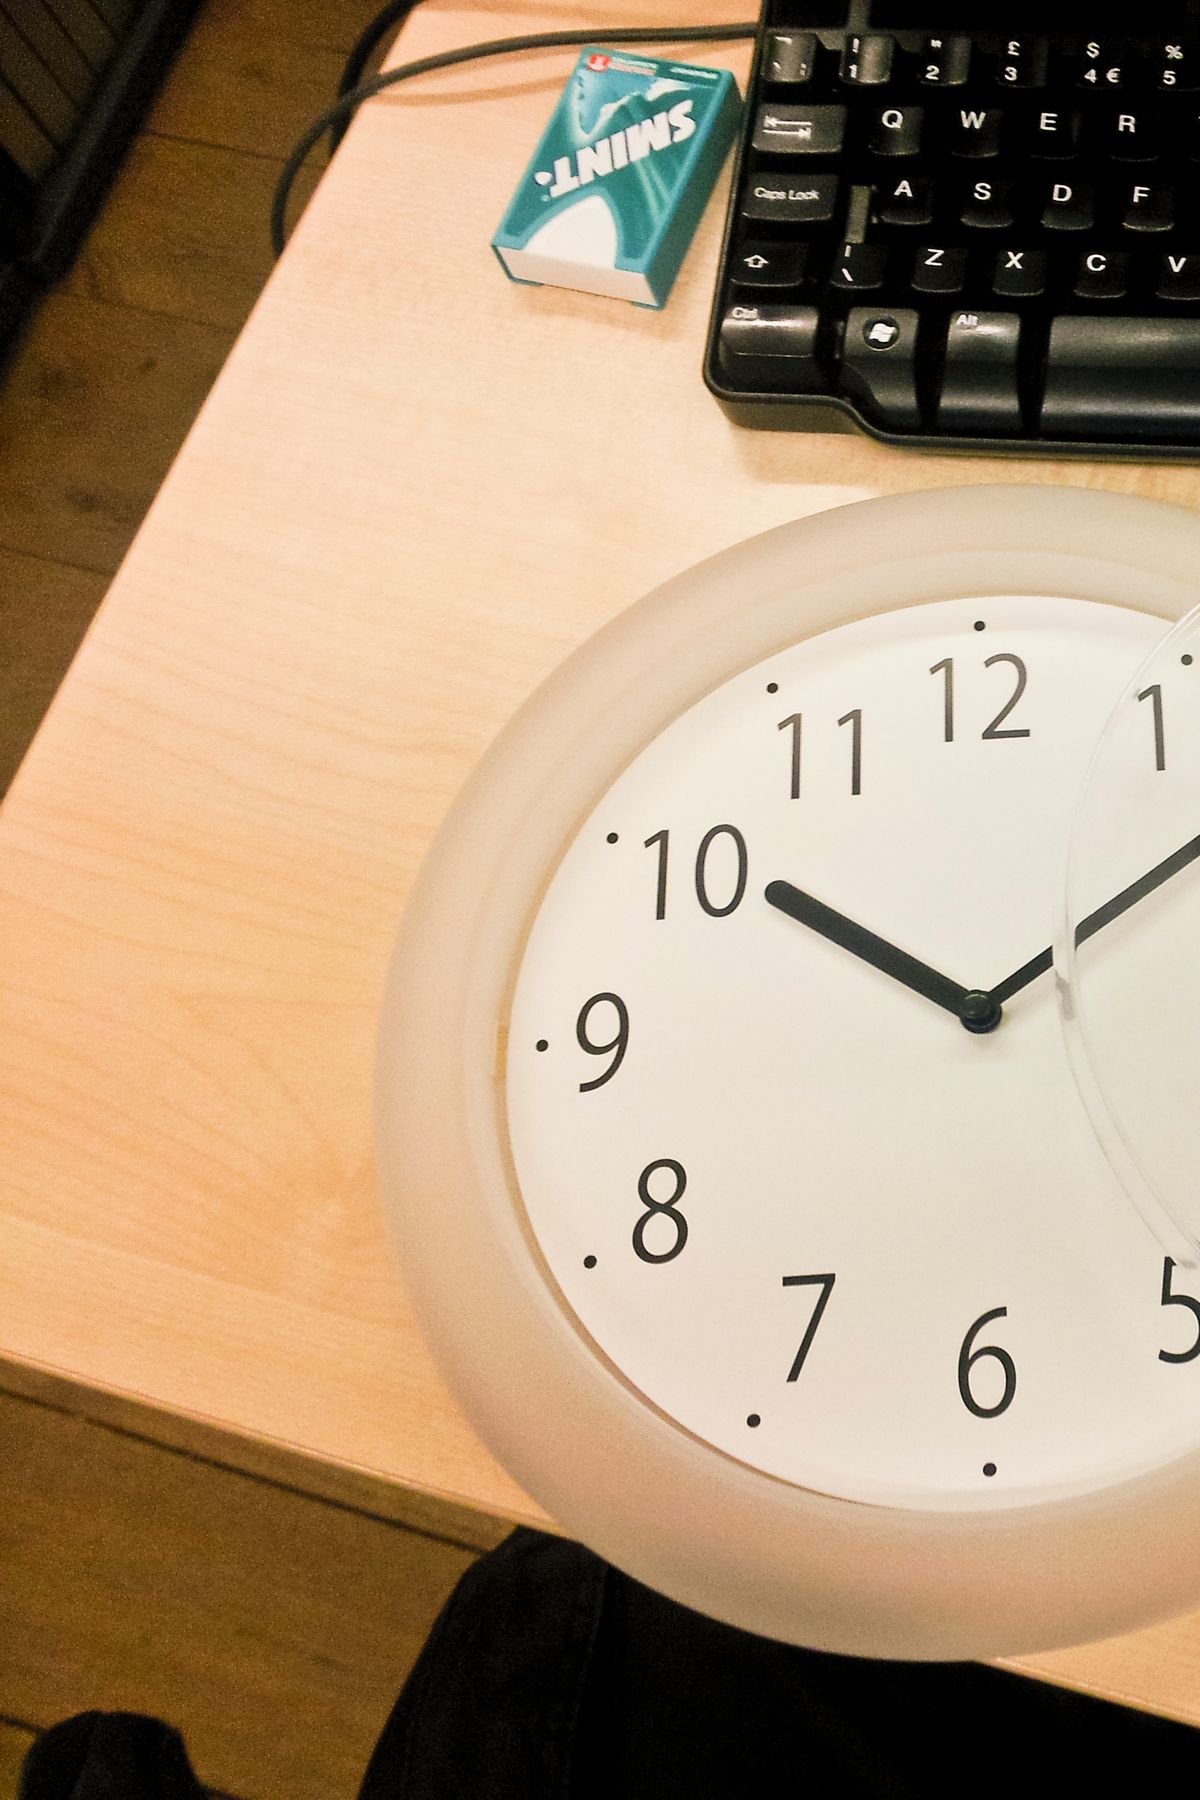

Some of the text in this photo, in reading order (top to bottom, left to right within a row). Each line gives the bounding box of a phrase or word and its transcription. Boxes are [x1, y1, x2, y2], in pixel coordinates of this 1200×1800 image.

[1007, 41, 1020, 56] £
[1086, 42, 1100, 59] $
[1165, 45, 1184, 60] %
[849, 64, 858, 79] 1
[925, 65, 940, 80] 2
[1004, 66, 1018, 81] 3
[1084, 67, 1121, 83] 4 €
[1163, 70, 1176, 85] 5
[881, 109, 904, 129] Q
[960, 110, 986, 130] W
[1040, 112, 1058, 131] E
[1118, 114, 1136, 133] R
[754, 187, 819, 203] Caps Lock
[894, 180, 913, 198] A
[973, 182, 992, 201] S
[1052, 184, 1072, 202] D
[1133, 186, 1150, 203] F
[924, 248, 945, 266] Z
[1004, 251, 1024, 269] X
[1086, 254, 1107, 272] C
[1168, 255, 1187, 273] V
[731, 306, 760, 320] Ctrl
[955, 313, 979, 328] Alt
[929, 653, 1031, 743] 12
[1137, 684, 1166, 772] 1
[777, 709, 862, 800] 11
[644, 823, 748, 921] 10
[576, 992, 630, 1093] 9
[632, 1158, 689, 1265] 8
[782, 1273, 836, 1383] 7
[957, 1306, 1017, 1419] 6
